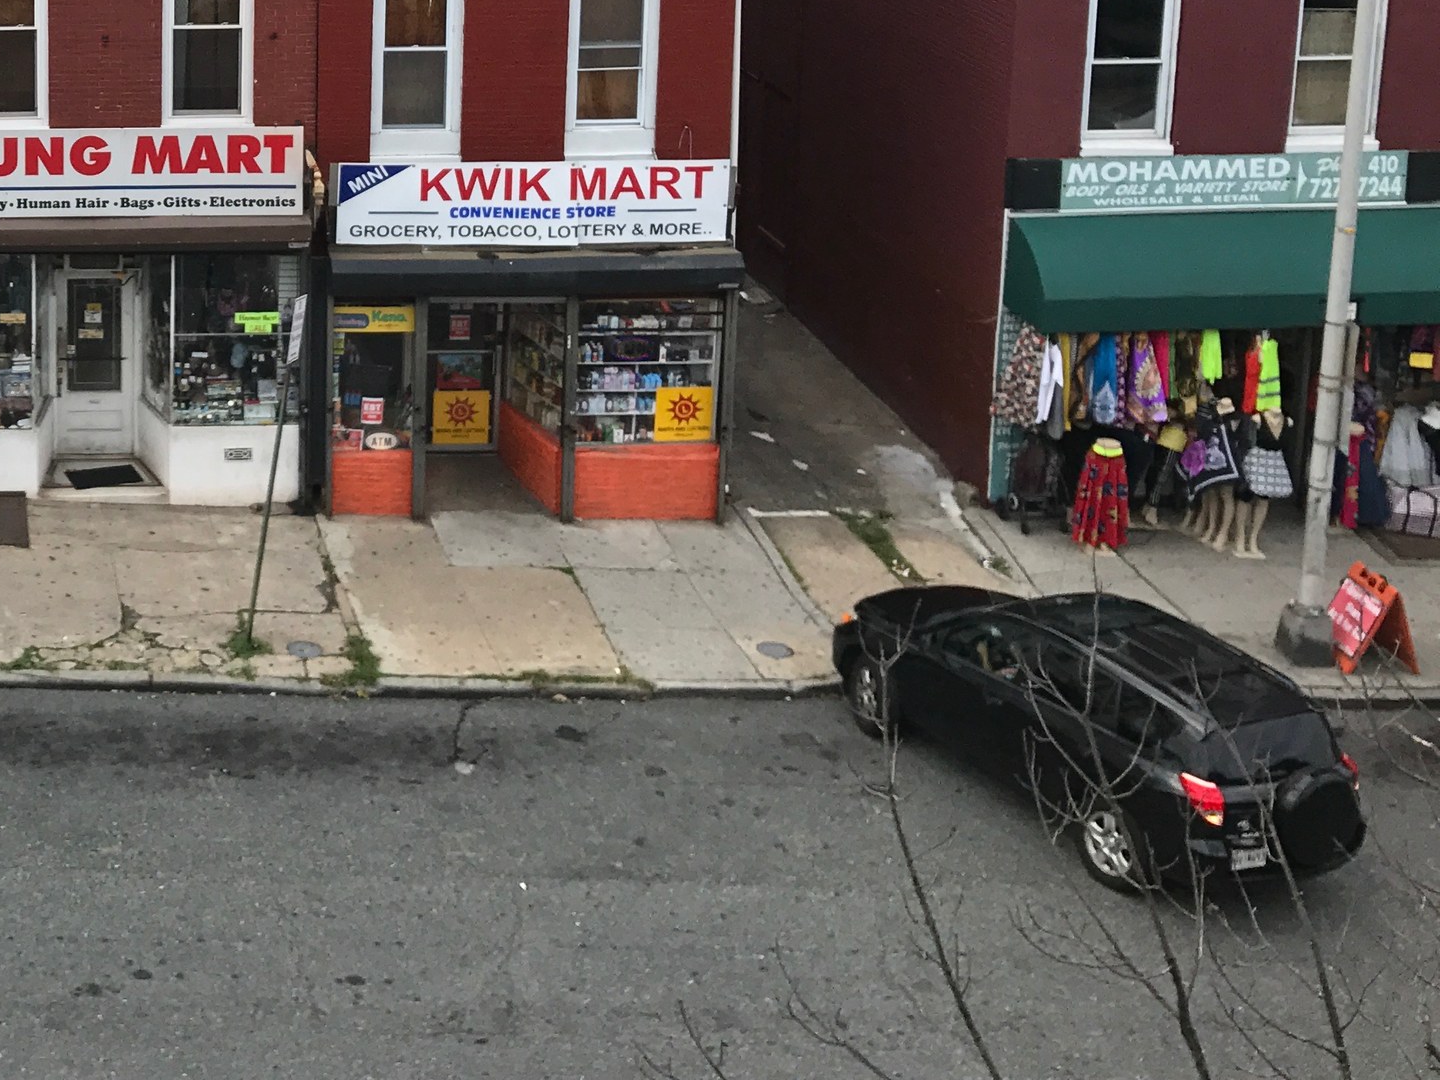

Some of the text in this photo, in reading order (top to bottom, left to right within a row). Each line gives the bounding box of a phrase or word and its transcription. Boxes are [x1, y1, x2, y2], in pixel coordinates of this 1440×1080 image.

[131, 134, 294, 174] MART
[1066, 157, 1291, 184] MOHAMMED
[1368, 155, 1399, 174] 410
[347, 165, 389, 194] MINI
[420, 165, 715, 202] KWIK MART
[1066, 185, 1109, 198] BODY
[1115, 183, 1149, 196] OILS
[1175, 181, 1237, 194] VARIETY
[1242, 180, 1291, 192] STORE
[75, 197, 110, 208] Hair
[1093, 196, 1184, 207] WHOLESALE
[1213, 194, 1260, 203] RETAIL
[449, 205, 616, 220] CONVENIENCE STORE
[349, 224, 442, 241] GROCERY,
[447, 224, 543, 241] TOBACCO,
[632, 223, 644, 236] &
[371, 437, 392, 446] ATM
